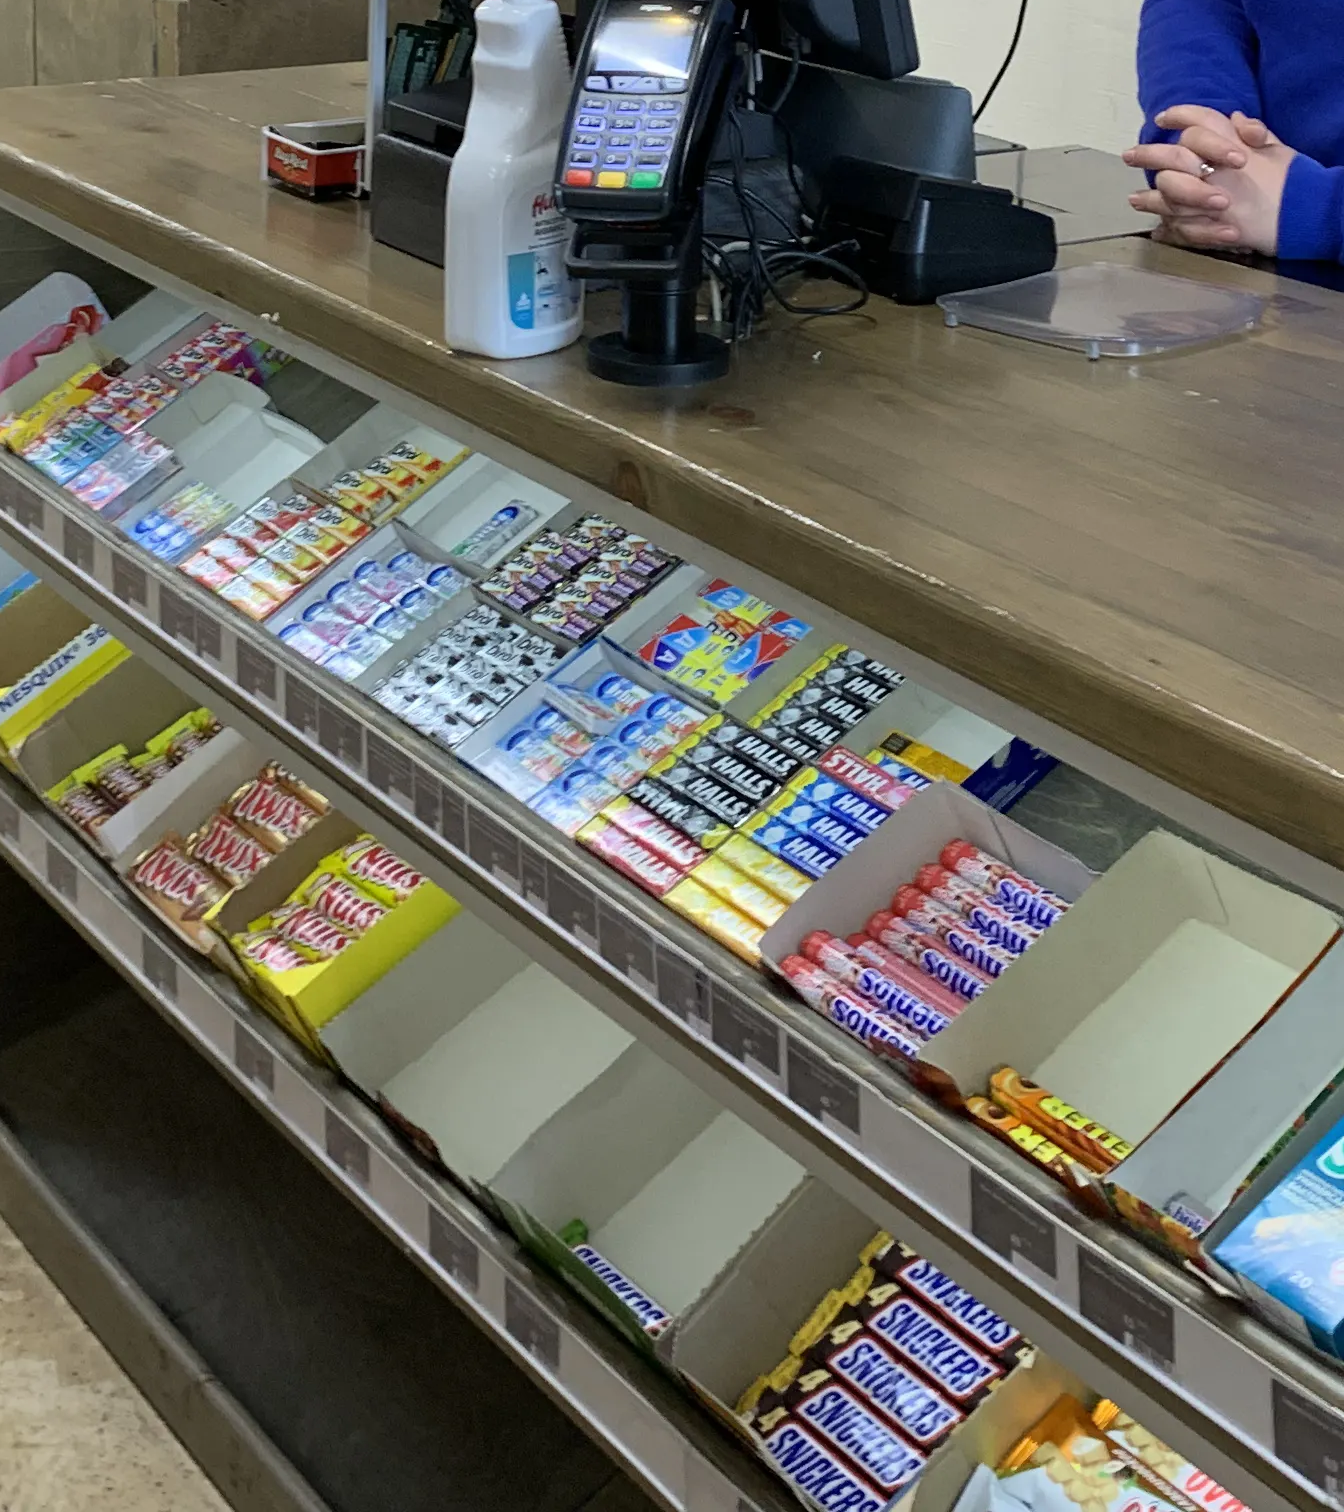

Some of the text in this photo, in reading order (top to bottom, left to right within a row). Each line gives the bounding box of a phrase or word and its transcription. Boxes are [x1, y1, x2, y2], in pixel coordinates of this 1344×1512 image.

[465, 608, 496, 627] Dirol
[486, 645, 518, 663] Dirol
[516, 638, 549, 657] Dirol
[711, 755, 774, 795] HALLS
[735, 736, 798, 775] HALLS
[825, 753, 889, 792] HALLS
[686, 777, 749, 817] HALLS
[908, 1259, 1013, 1345] SNICKERS
[877, 1301, 991, 1393] SNICKERS
[838, 1343, 950, 1437] SNICKERS
[804, 1390, 921, 1485] SNICKERS
